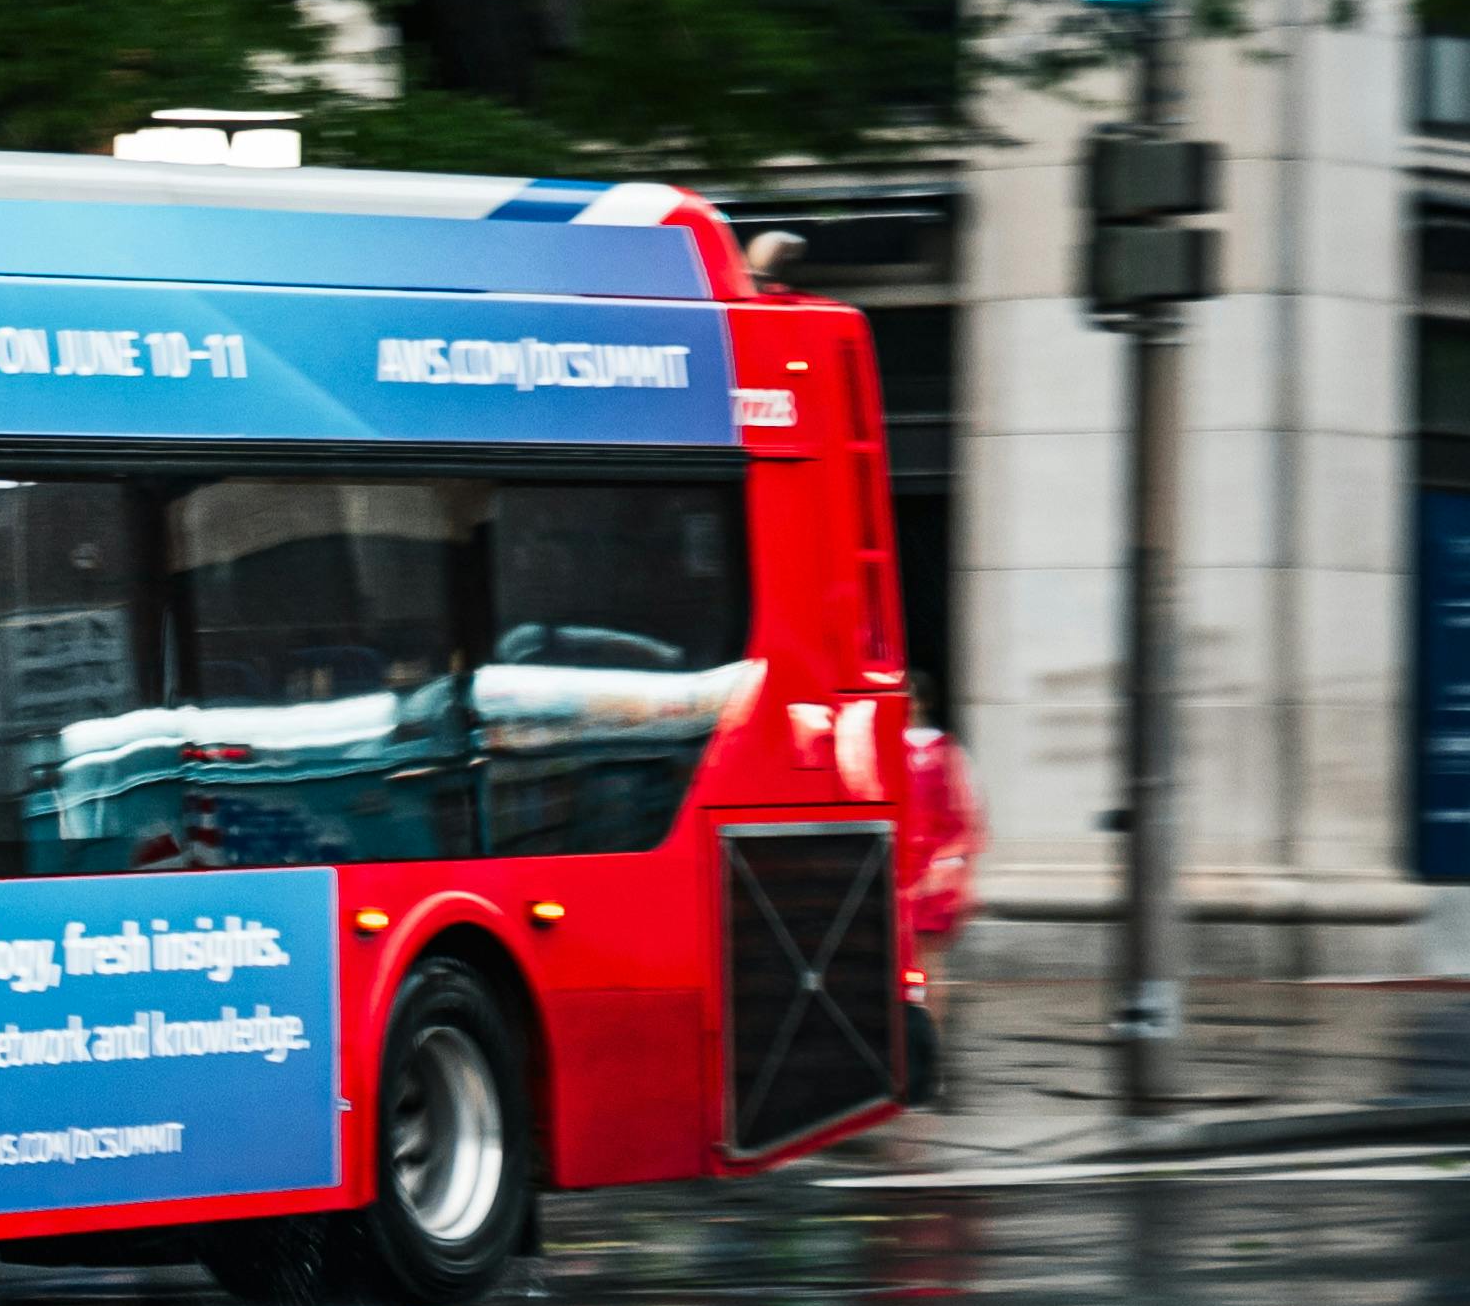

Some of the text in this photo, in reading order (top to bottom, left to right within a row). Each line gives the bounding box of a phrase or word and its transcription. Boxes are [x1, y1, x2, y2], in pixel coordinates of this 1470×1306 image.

[54, 330, 144, 376] JUNE
[144, 331, 247, 378] 10-11
[63, 922, 151, 975] fresh
[151, 916, 290, 983] insights.
[92, 1011, 150, 1061] and
[150, 1004, 311, 1063] knowledge.
